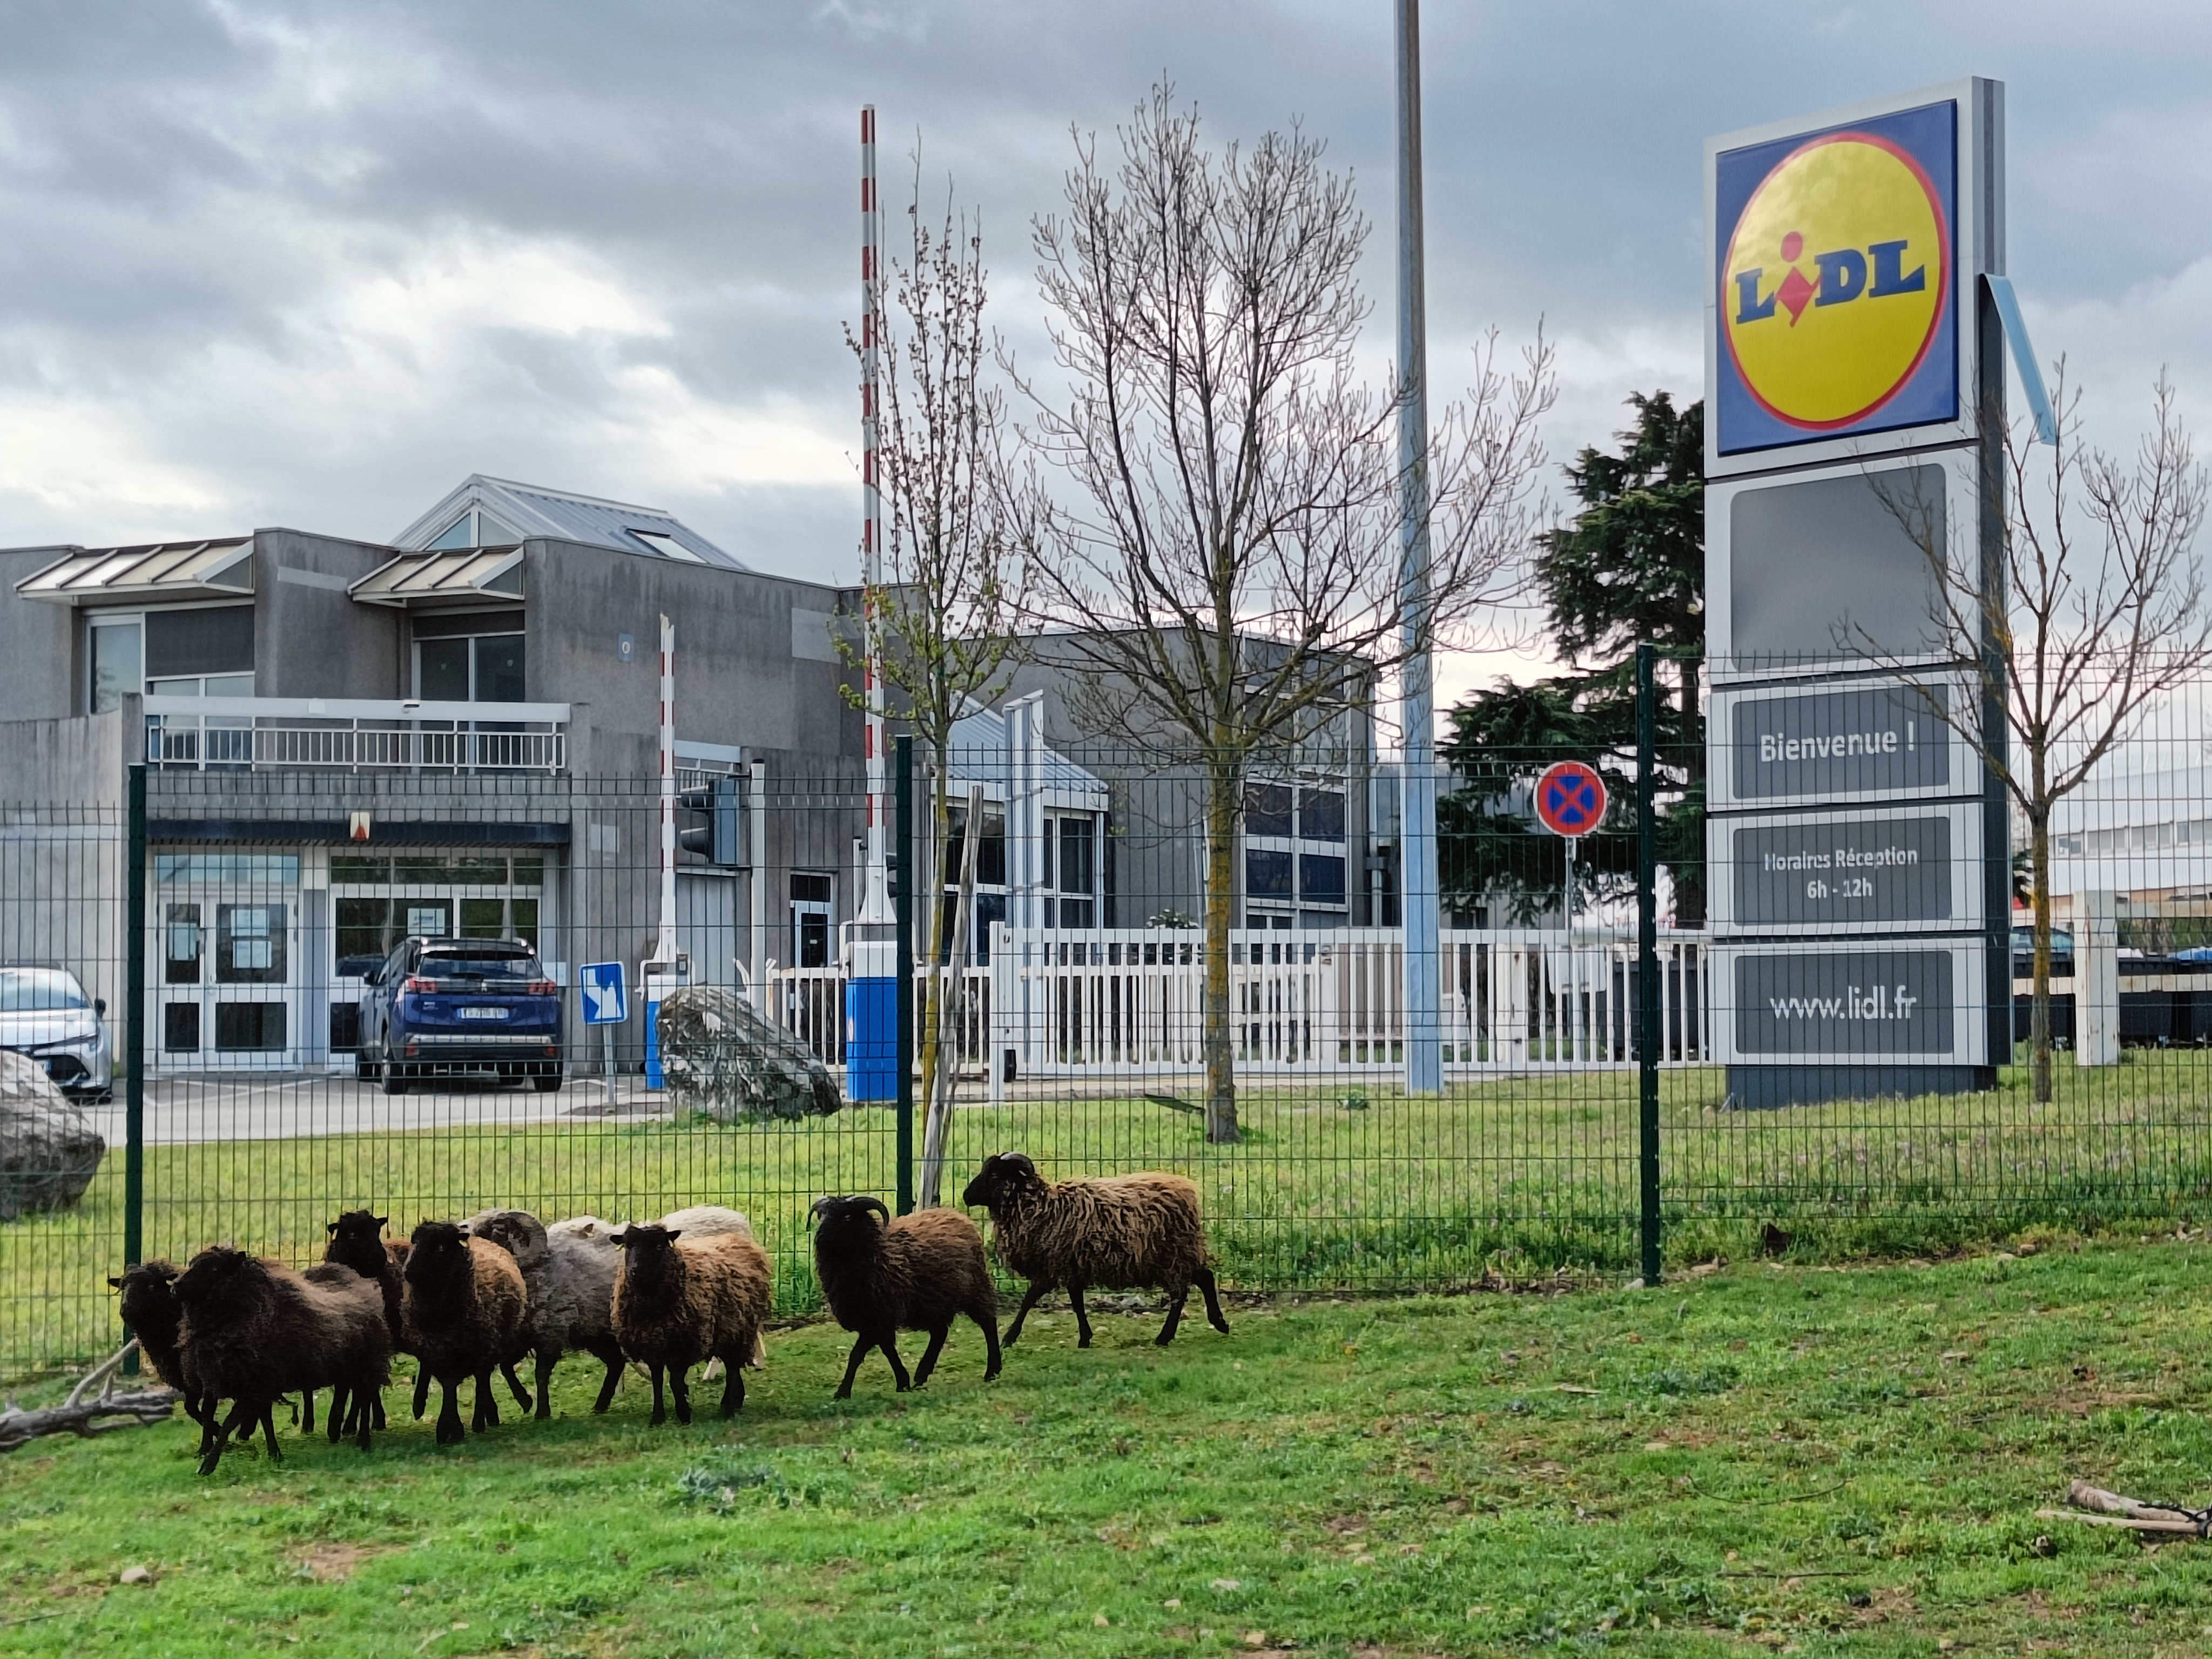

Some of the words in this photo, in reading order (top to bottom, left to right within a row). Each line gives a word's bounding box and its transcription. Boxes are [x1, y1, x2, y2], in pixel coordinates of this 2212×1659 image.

[1760, 731, 1898, 762] Bienvenue
[1835, 846, 1918, 870] Réception
[1807, 879, 1827, 899] 6h
[1843, 877, 1873, 898] 12h
[1769, 984, 1917, 1020] www.lidl.fr
